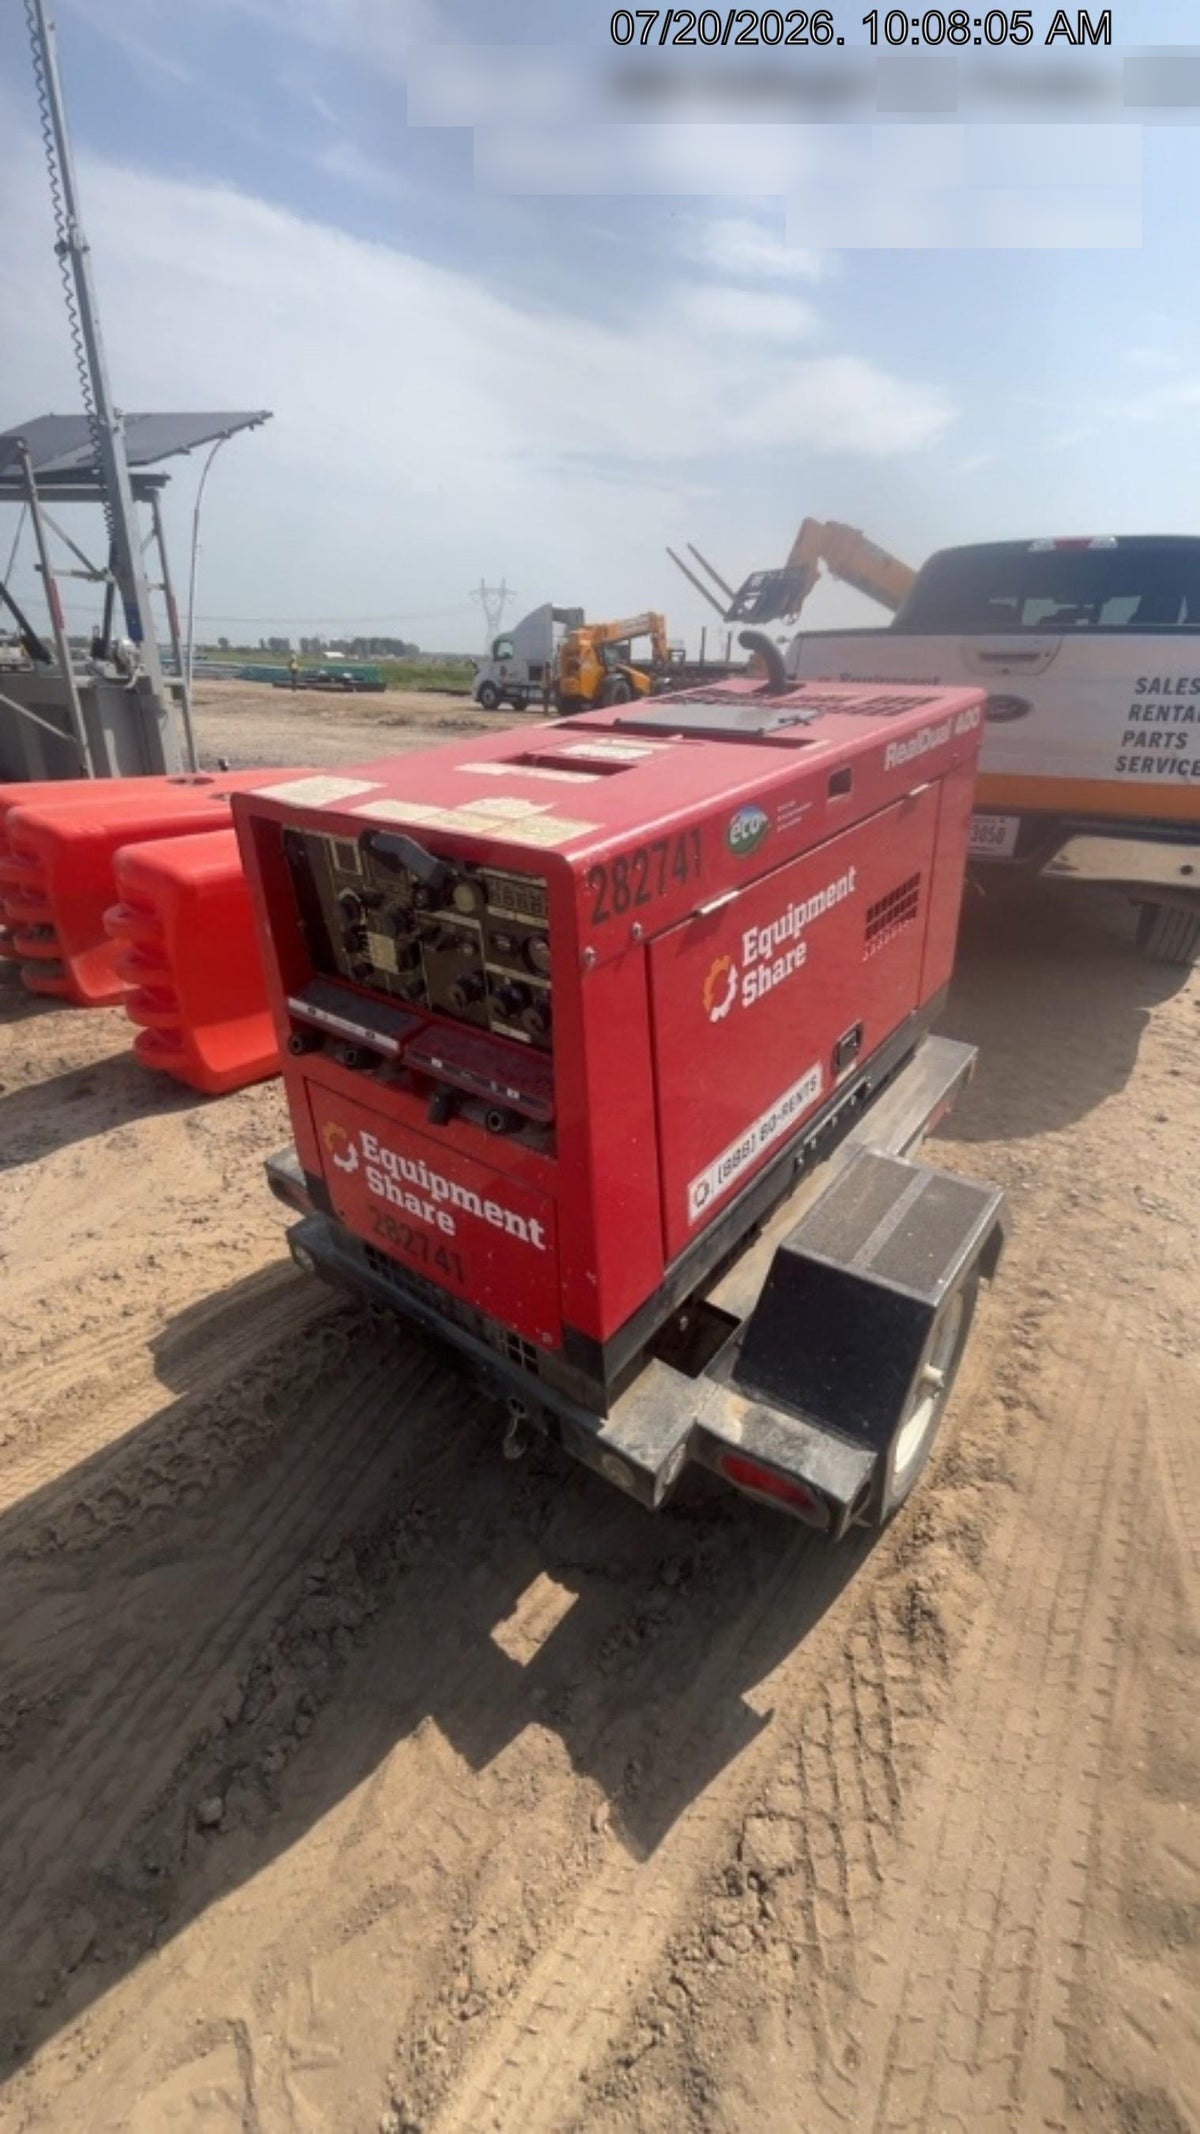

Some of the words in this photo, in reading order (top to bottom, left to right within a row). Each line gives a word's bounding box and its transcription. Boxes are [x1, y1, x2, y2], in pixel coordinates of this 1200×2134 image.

[1128, 703, 1200, 722] RENTA
[1134, 677, 1200, 696] SALES
[1121, 729, 1188, 750] PARTS
[587, 826, 702, 927] 282741
[742, 864, 857, 968] Equipment
[742, 941, 808, 1009] Share
[359, 1129, 547, 1251] Equipment
[365, 1165, 457, 1236] Share
[366, 1205, 466, 1284] 282741
